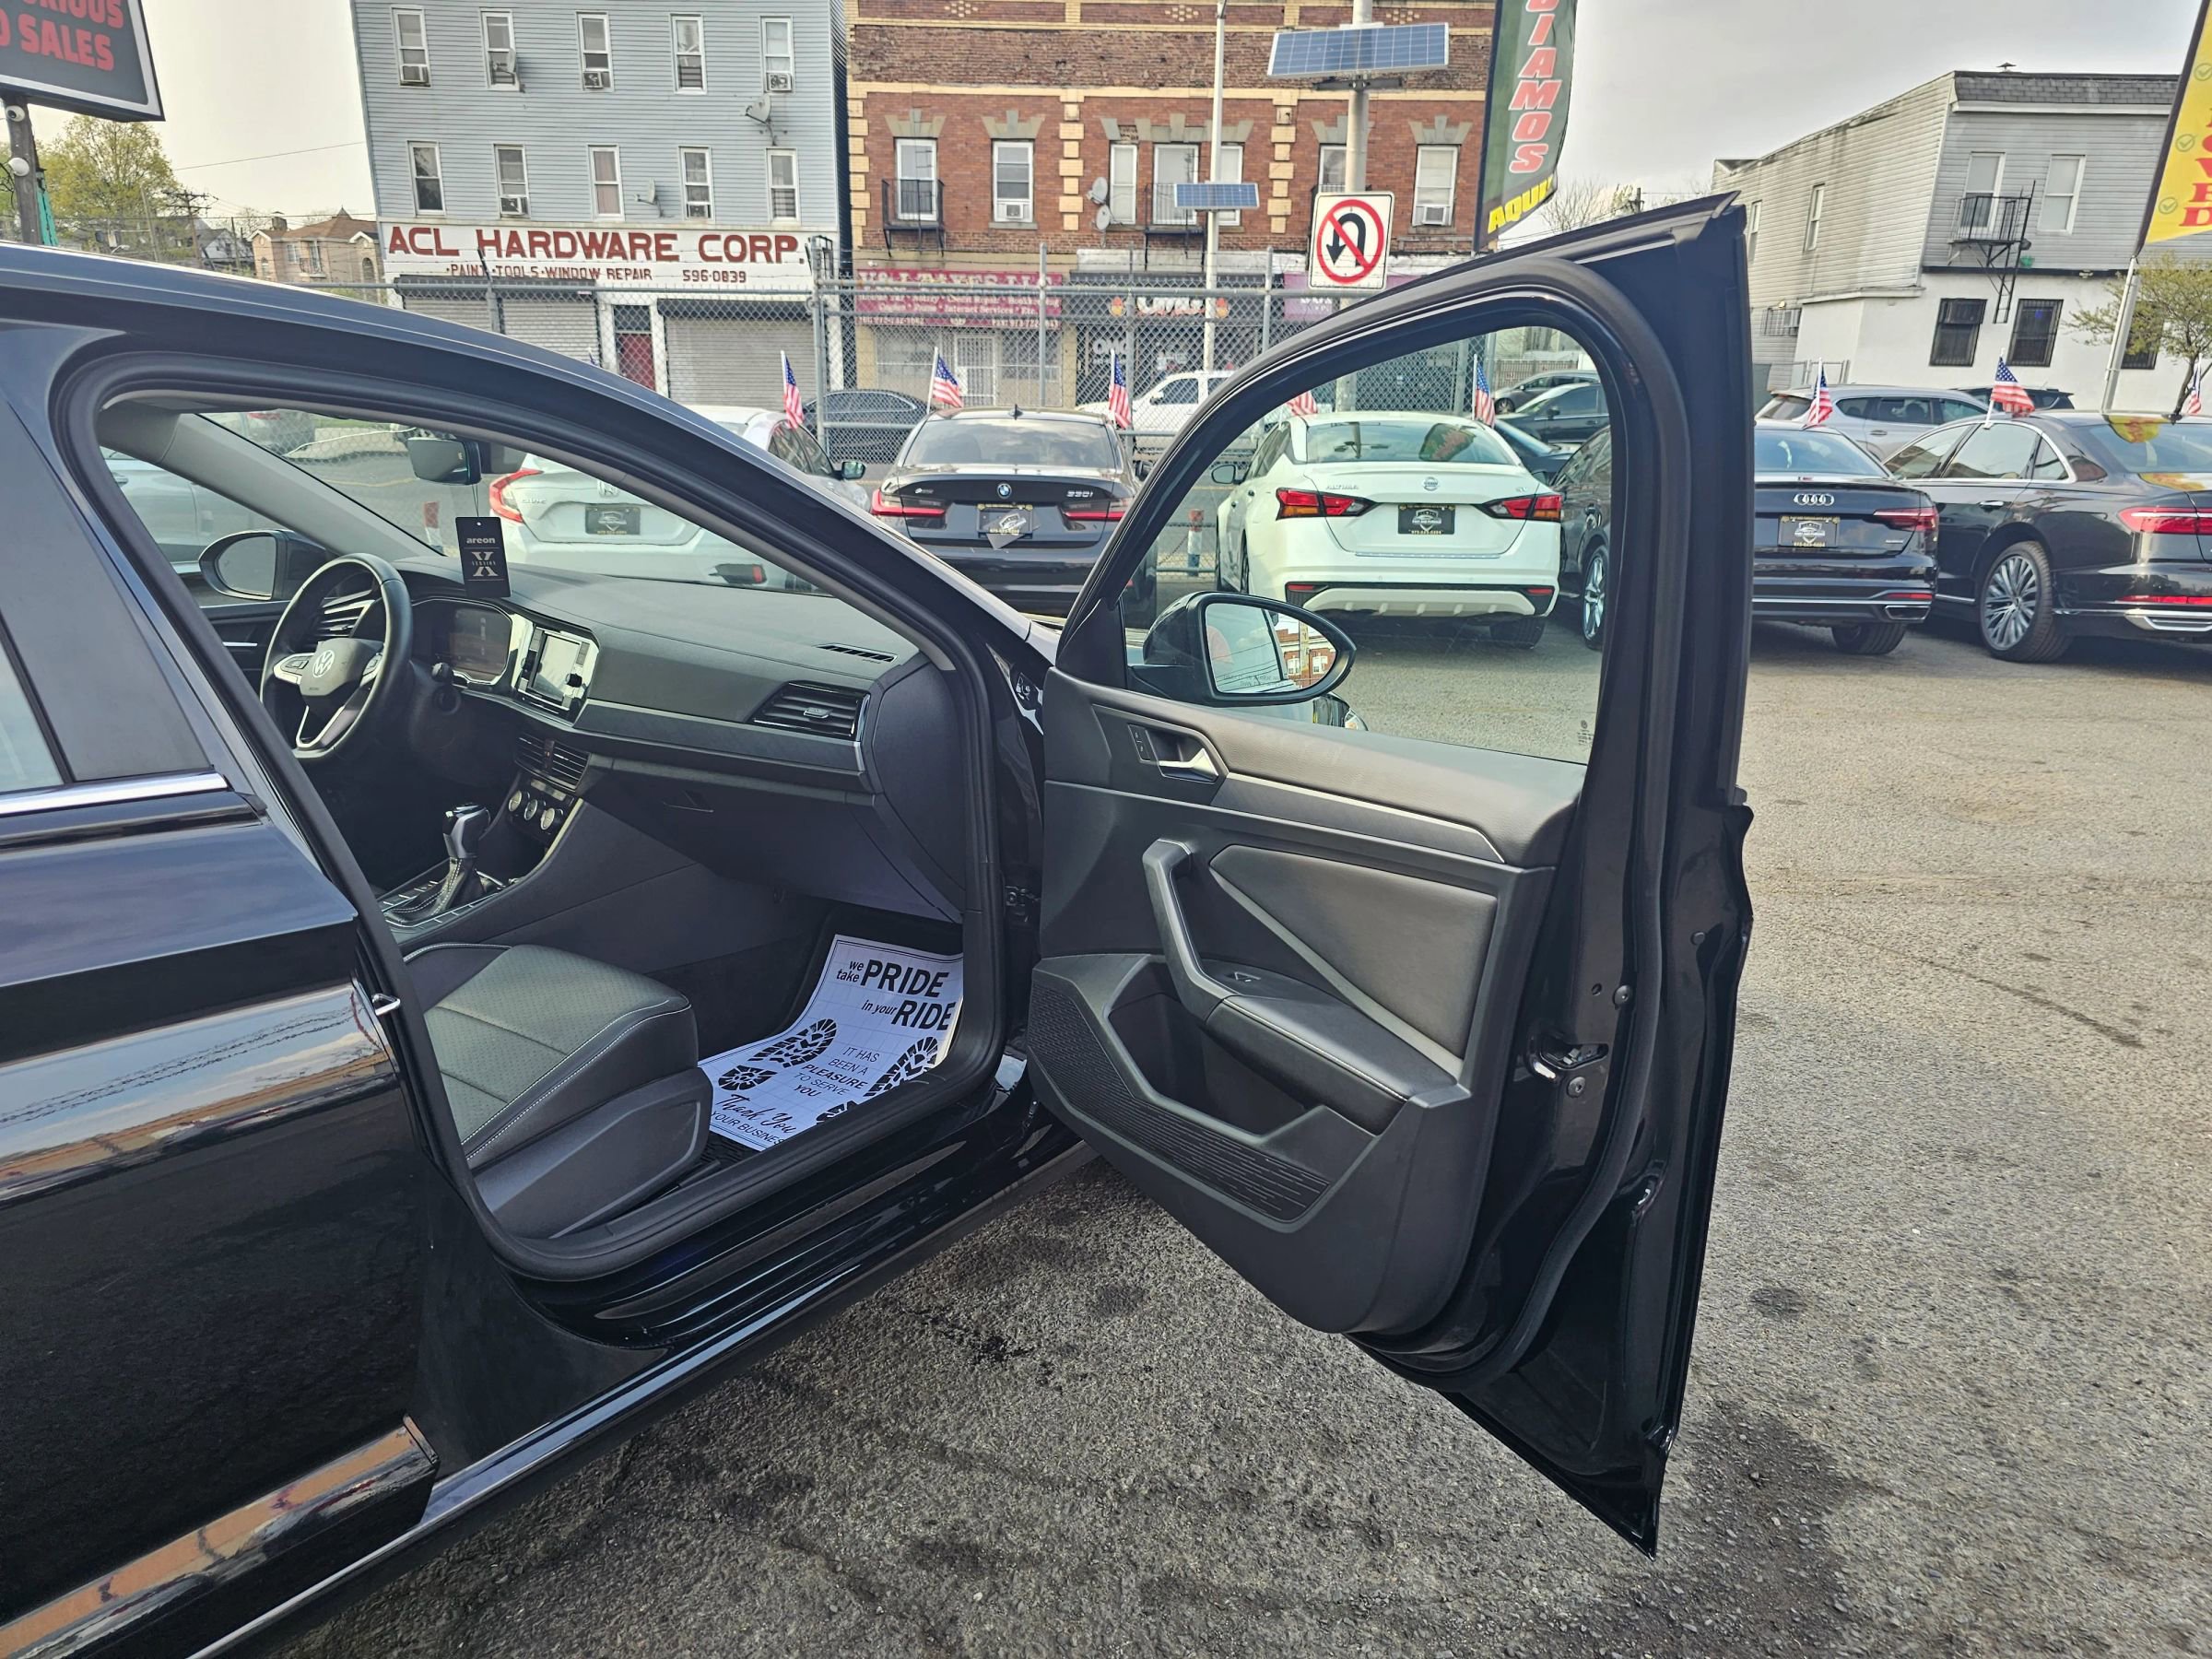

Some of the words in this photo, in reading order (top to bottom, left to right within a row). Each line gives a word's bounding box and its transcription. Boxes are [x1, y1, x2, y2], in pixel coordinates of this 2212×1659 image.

[18, 13, 114, 71] SALES
[388, 226, 460, 256] ACL
[476, 229, 680, 262] HARDWARE
[698, 234, 805, 265] CORP.
[606, 267, 653, 281] REPAIR
[979, 305, 1014, 314] Services
[849, 960, 865, 971] we
[836, 969, 860, 982] take
[860, 959, 949, 998] PRIDE
[861, 999, 873, 1011] in
[871, 1004, 898, 1015] your
[890, 1000, 957, 1030] RIDE
[842, 1046, 858, 1055] IT
[855, 1050, 880, 1063] HAS
[802, 1064, 868, 1089] PLEASURE
[828, 1058, 858, 1072] BEEN
[857, 1066, 868, 1076] A
[794, 1072, 811, 1082] TO
[810, 1078, 850, 1096] SERVE
[794, 1084, 822, 1097] YOU
[711, 1111, 741, 1127] YOUR
[715, 1093, 776, 1121] Thank
[760, 1112, 797, 1134] You
